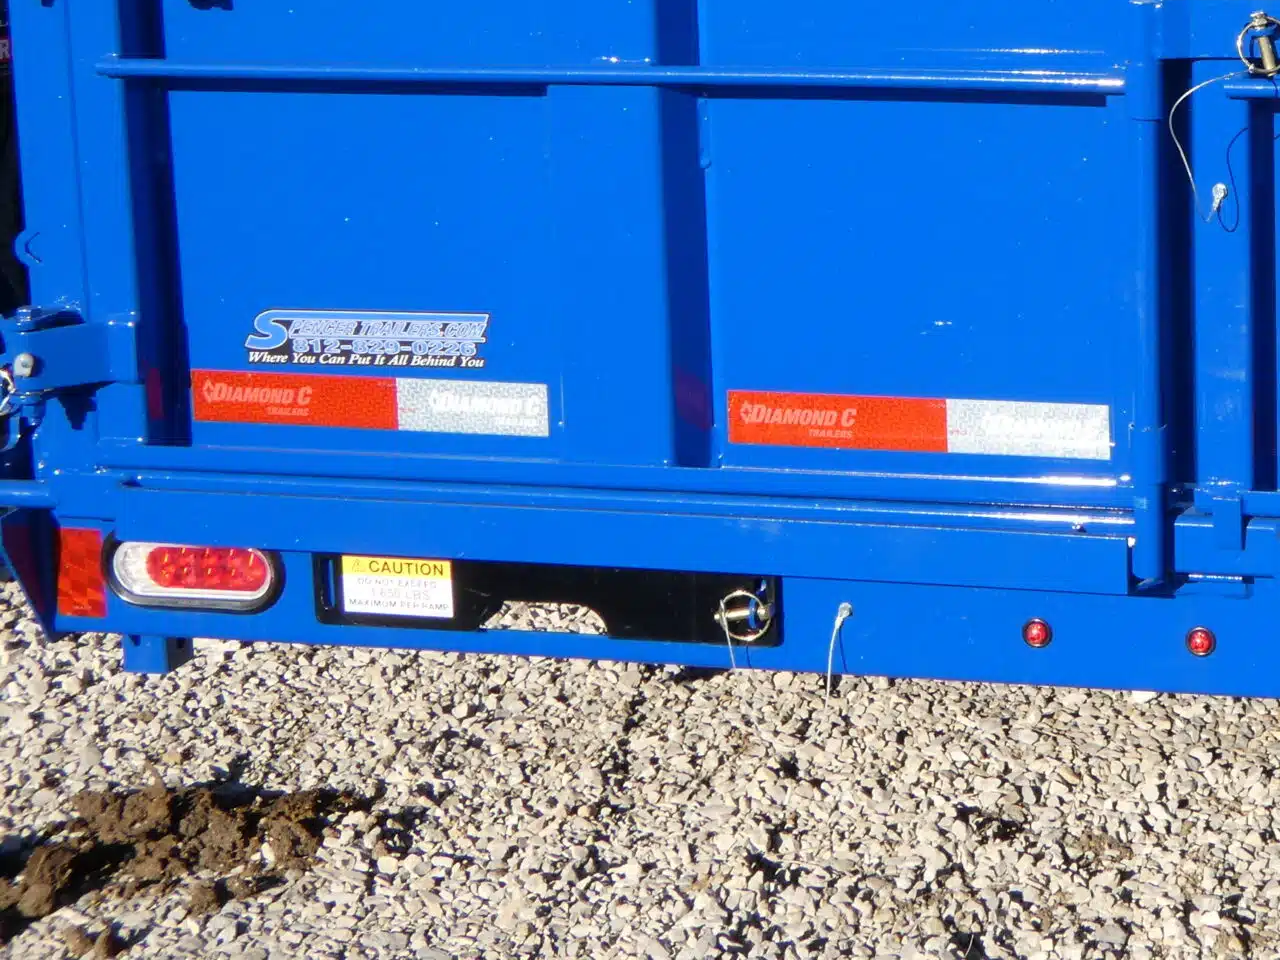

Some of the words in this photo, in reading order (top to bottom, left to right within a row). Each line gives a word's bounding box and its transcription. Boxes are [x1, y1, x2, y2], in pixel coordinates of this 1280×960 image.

[292, 337, 477, 356] 812-829-0226
[248, 351, 289, 364] Where
[292, 352, 316, 364] You
[319, 353, 345, 365] Can
[347, 353, 371, 366] Put
[373, 354, 386, 366] It
[388, 354, 407, 367] All
[410, 355, 456, 367] Behind
[459, 356, 485, 368] You
[211, 382, 295, 405] DIAMOND
[297, 385, 313, 406] C
[266, 406, 310, 417] TRAILERS
[750, 404, 838, 427] DIAMOND
[840, 408, 857, 428] C
[808, 428, 853, 439] TRAILERS
[368, 559, 444, 576] CAUTION
